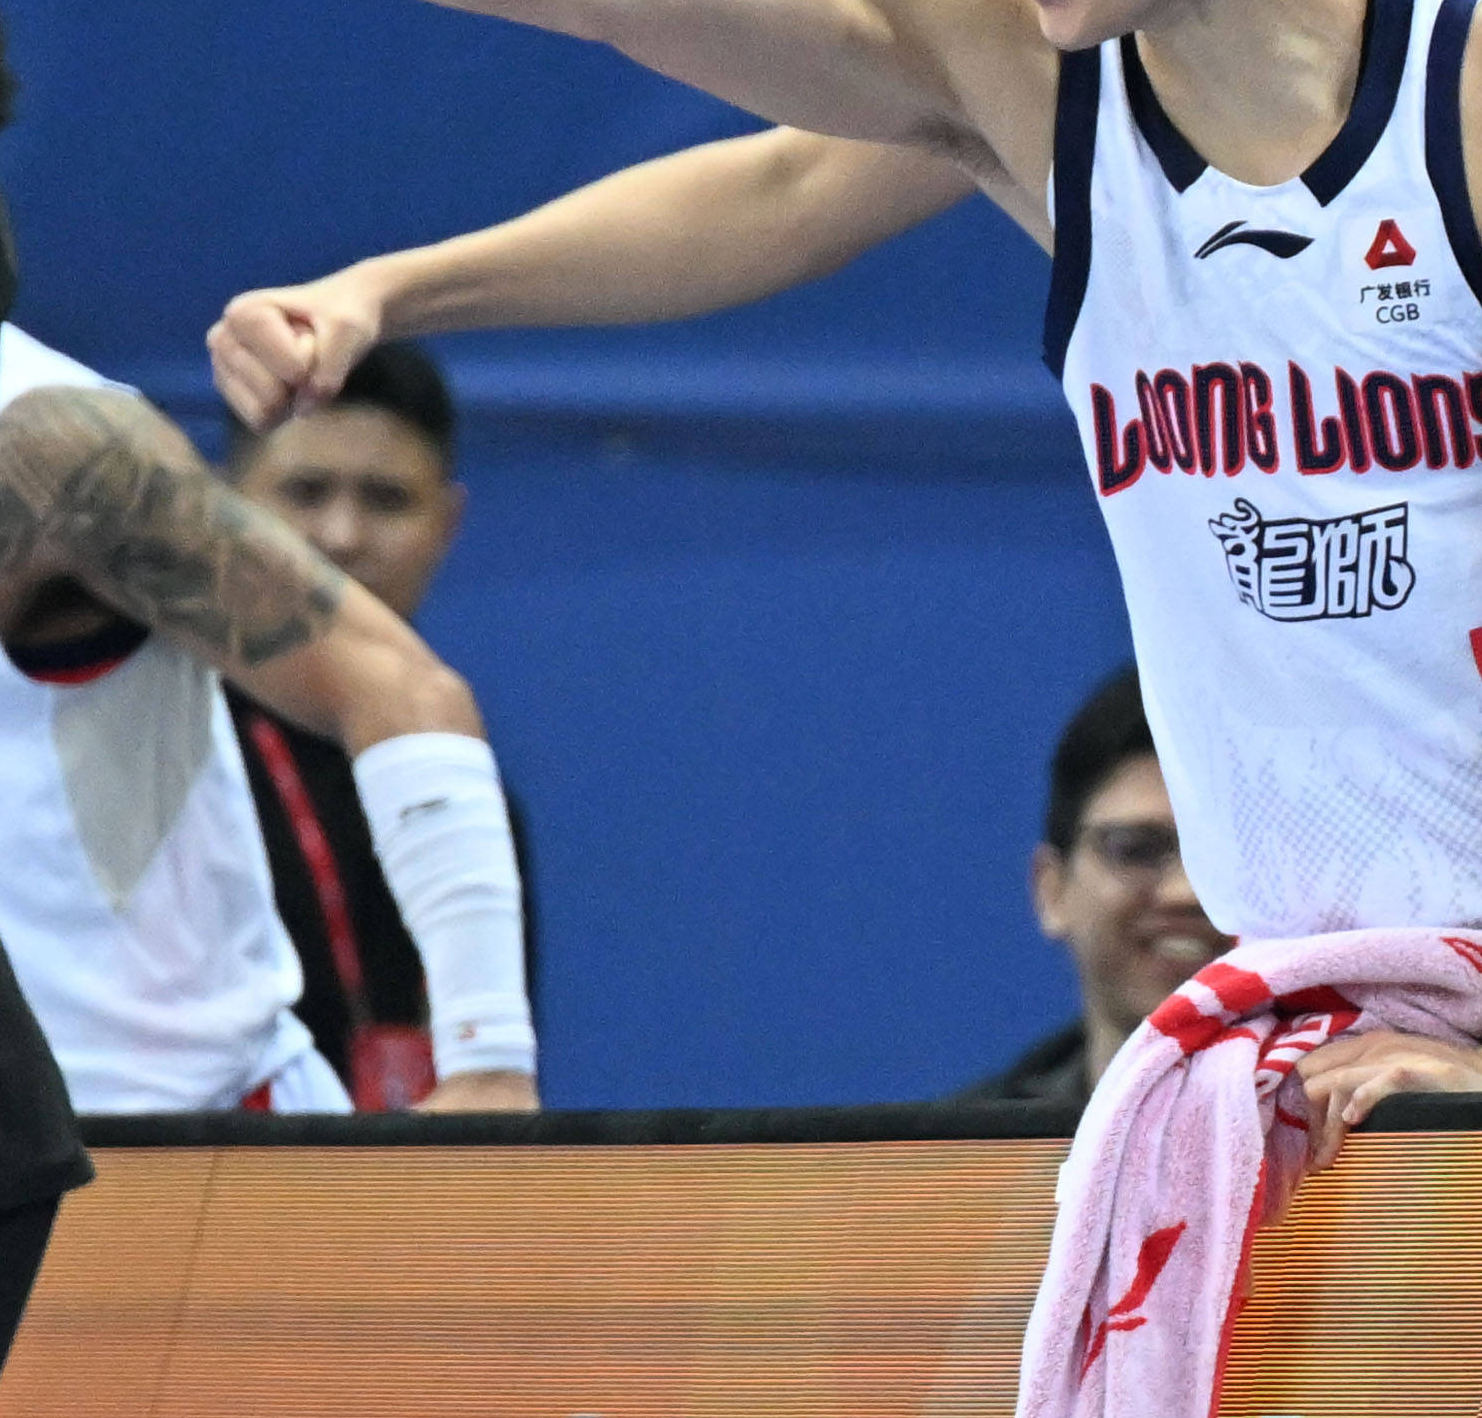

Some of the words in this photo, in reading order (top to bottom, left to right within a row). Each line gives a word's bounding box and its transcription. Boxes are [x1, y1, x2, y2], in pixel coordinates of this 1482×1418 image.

[1359, 278, 1432, 304] 广发银行
[1375, 302, 1420, 325] CGB
